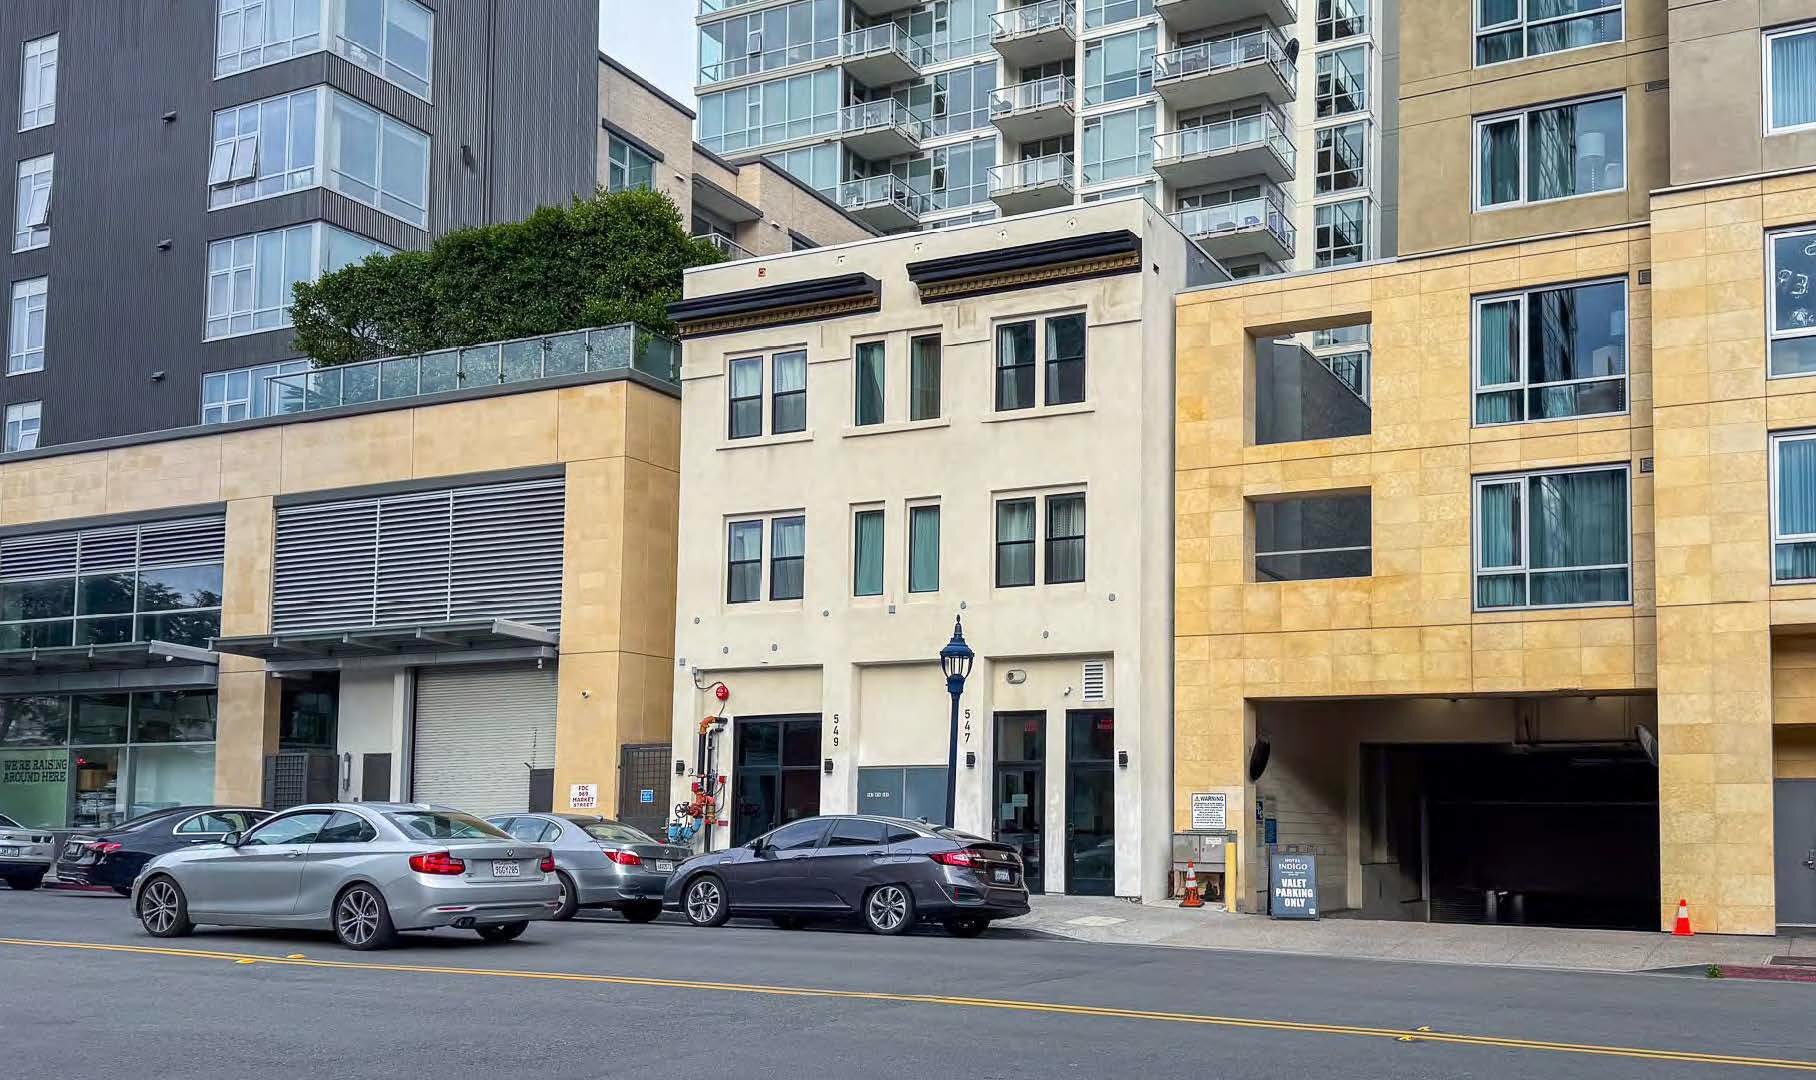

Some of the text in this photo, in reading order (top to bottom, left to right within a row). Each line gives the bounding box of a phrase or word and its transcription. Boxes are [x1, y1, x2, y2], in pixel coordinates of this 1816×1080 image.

[32, 759, 67, 770] RAISING
[3, 771, 66, 782] AROUND HERE
[1281, 878, 1307, 888] VALET
[1275, 887, 1314, 898] PARKING
[1284, 897, 1306, 908] ONLY
